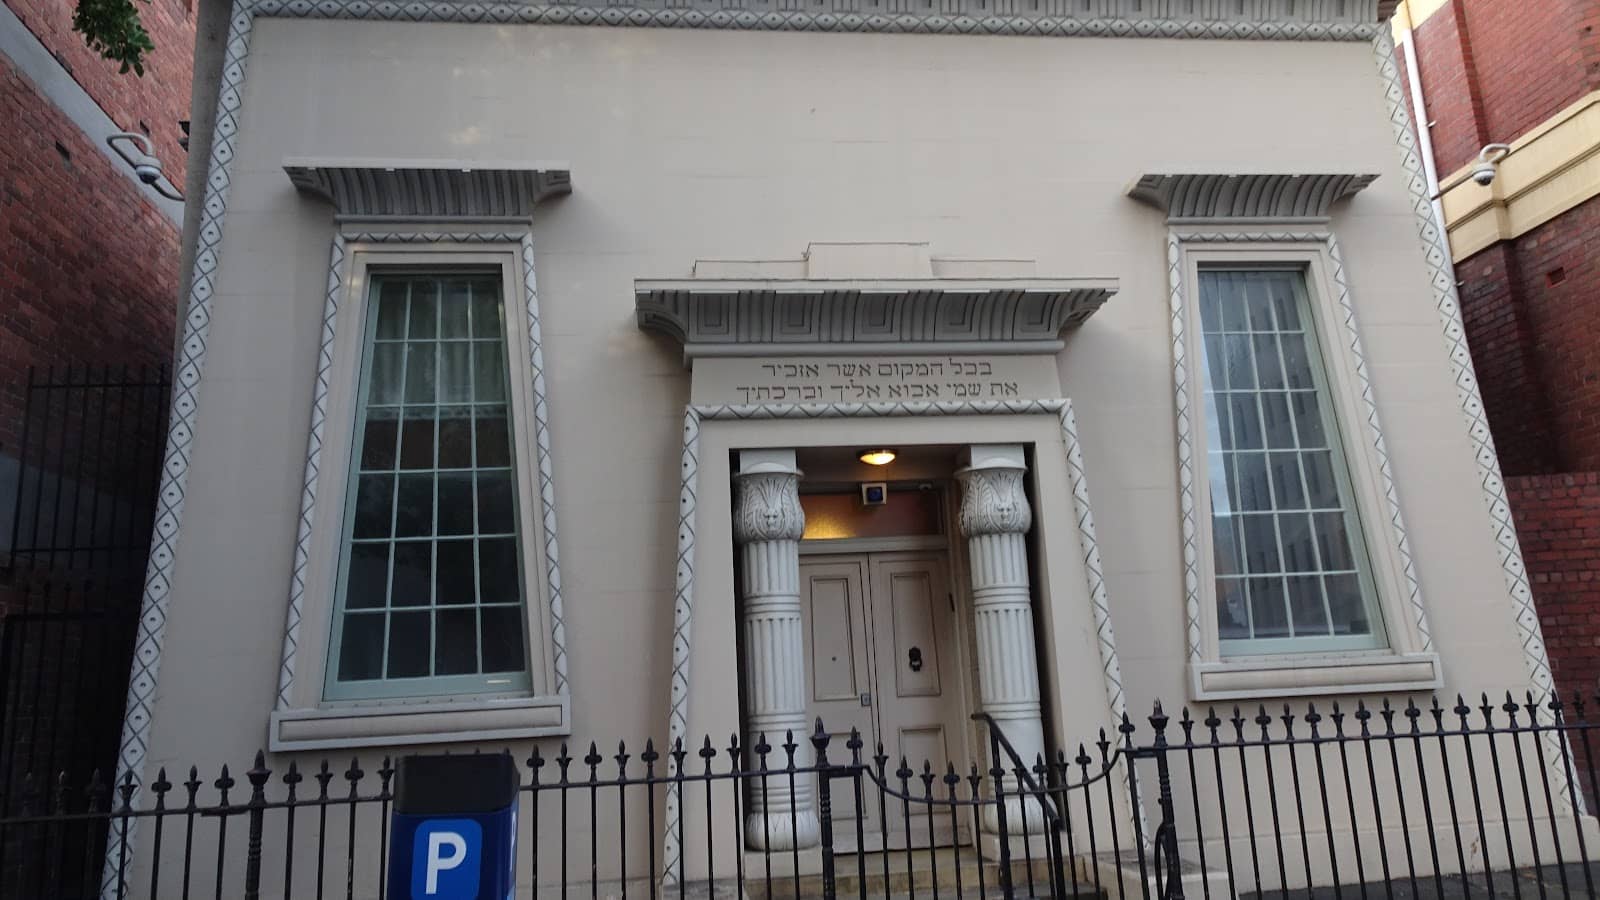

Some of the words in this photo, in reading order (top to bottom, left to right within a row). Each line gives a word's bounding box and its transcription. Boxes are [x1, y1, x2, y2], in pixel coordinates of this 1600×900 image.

[761, 363, 819, 378] אזכיר
[827, 363, 871, 377] אשר
[878, 362, 943, 381] המקום
[949, 357, 992, 376] בכל
[736, 385, 823, 404] וברכתיך
[830, 379, 881, 402] אליך
[888, 383, 940, 399] אבוא
[946, 382, 982, 397] שמי
[990, 382, 1019, 397] את
[425, 831, 467, 895] P
